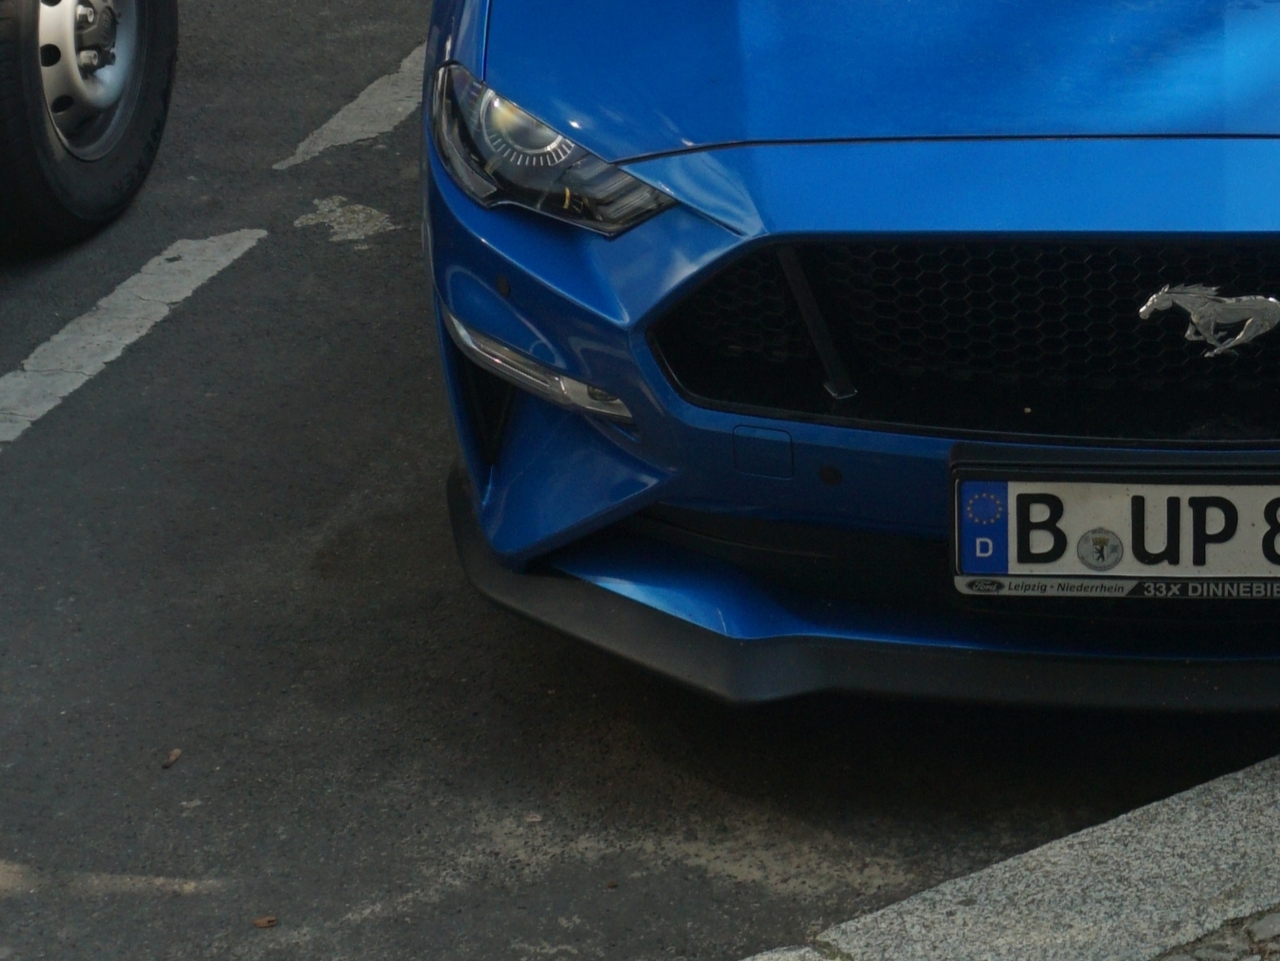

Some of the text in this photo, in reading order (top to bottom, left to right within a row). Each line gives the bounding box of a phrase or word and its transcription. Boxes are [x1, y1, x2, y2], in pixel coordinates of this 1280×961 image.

[1016, 492, 1068, 565] B
[1130, 495, 1239, 566] UP
[975, 537, 993, 558] D
[1008, 581, 1125, 594] Leipzig Niederrhein
